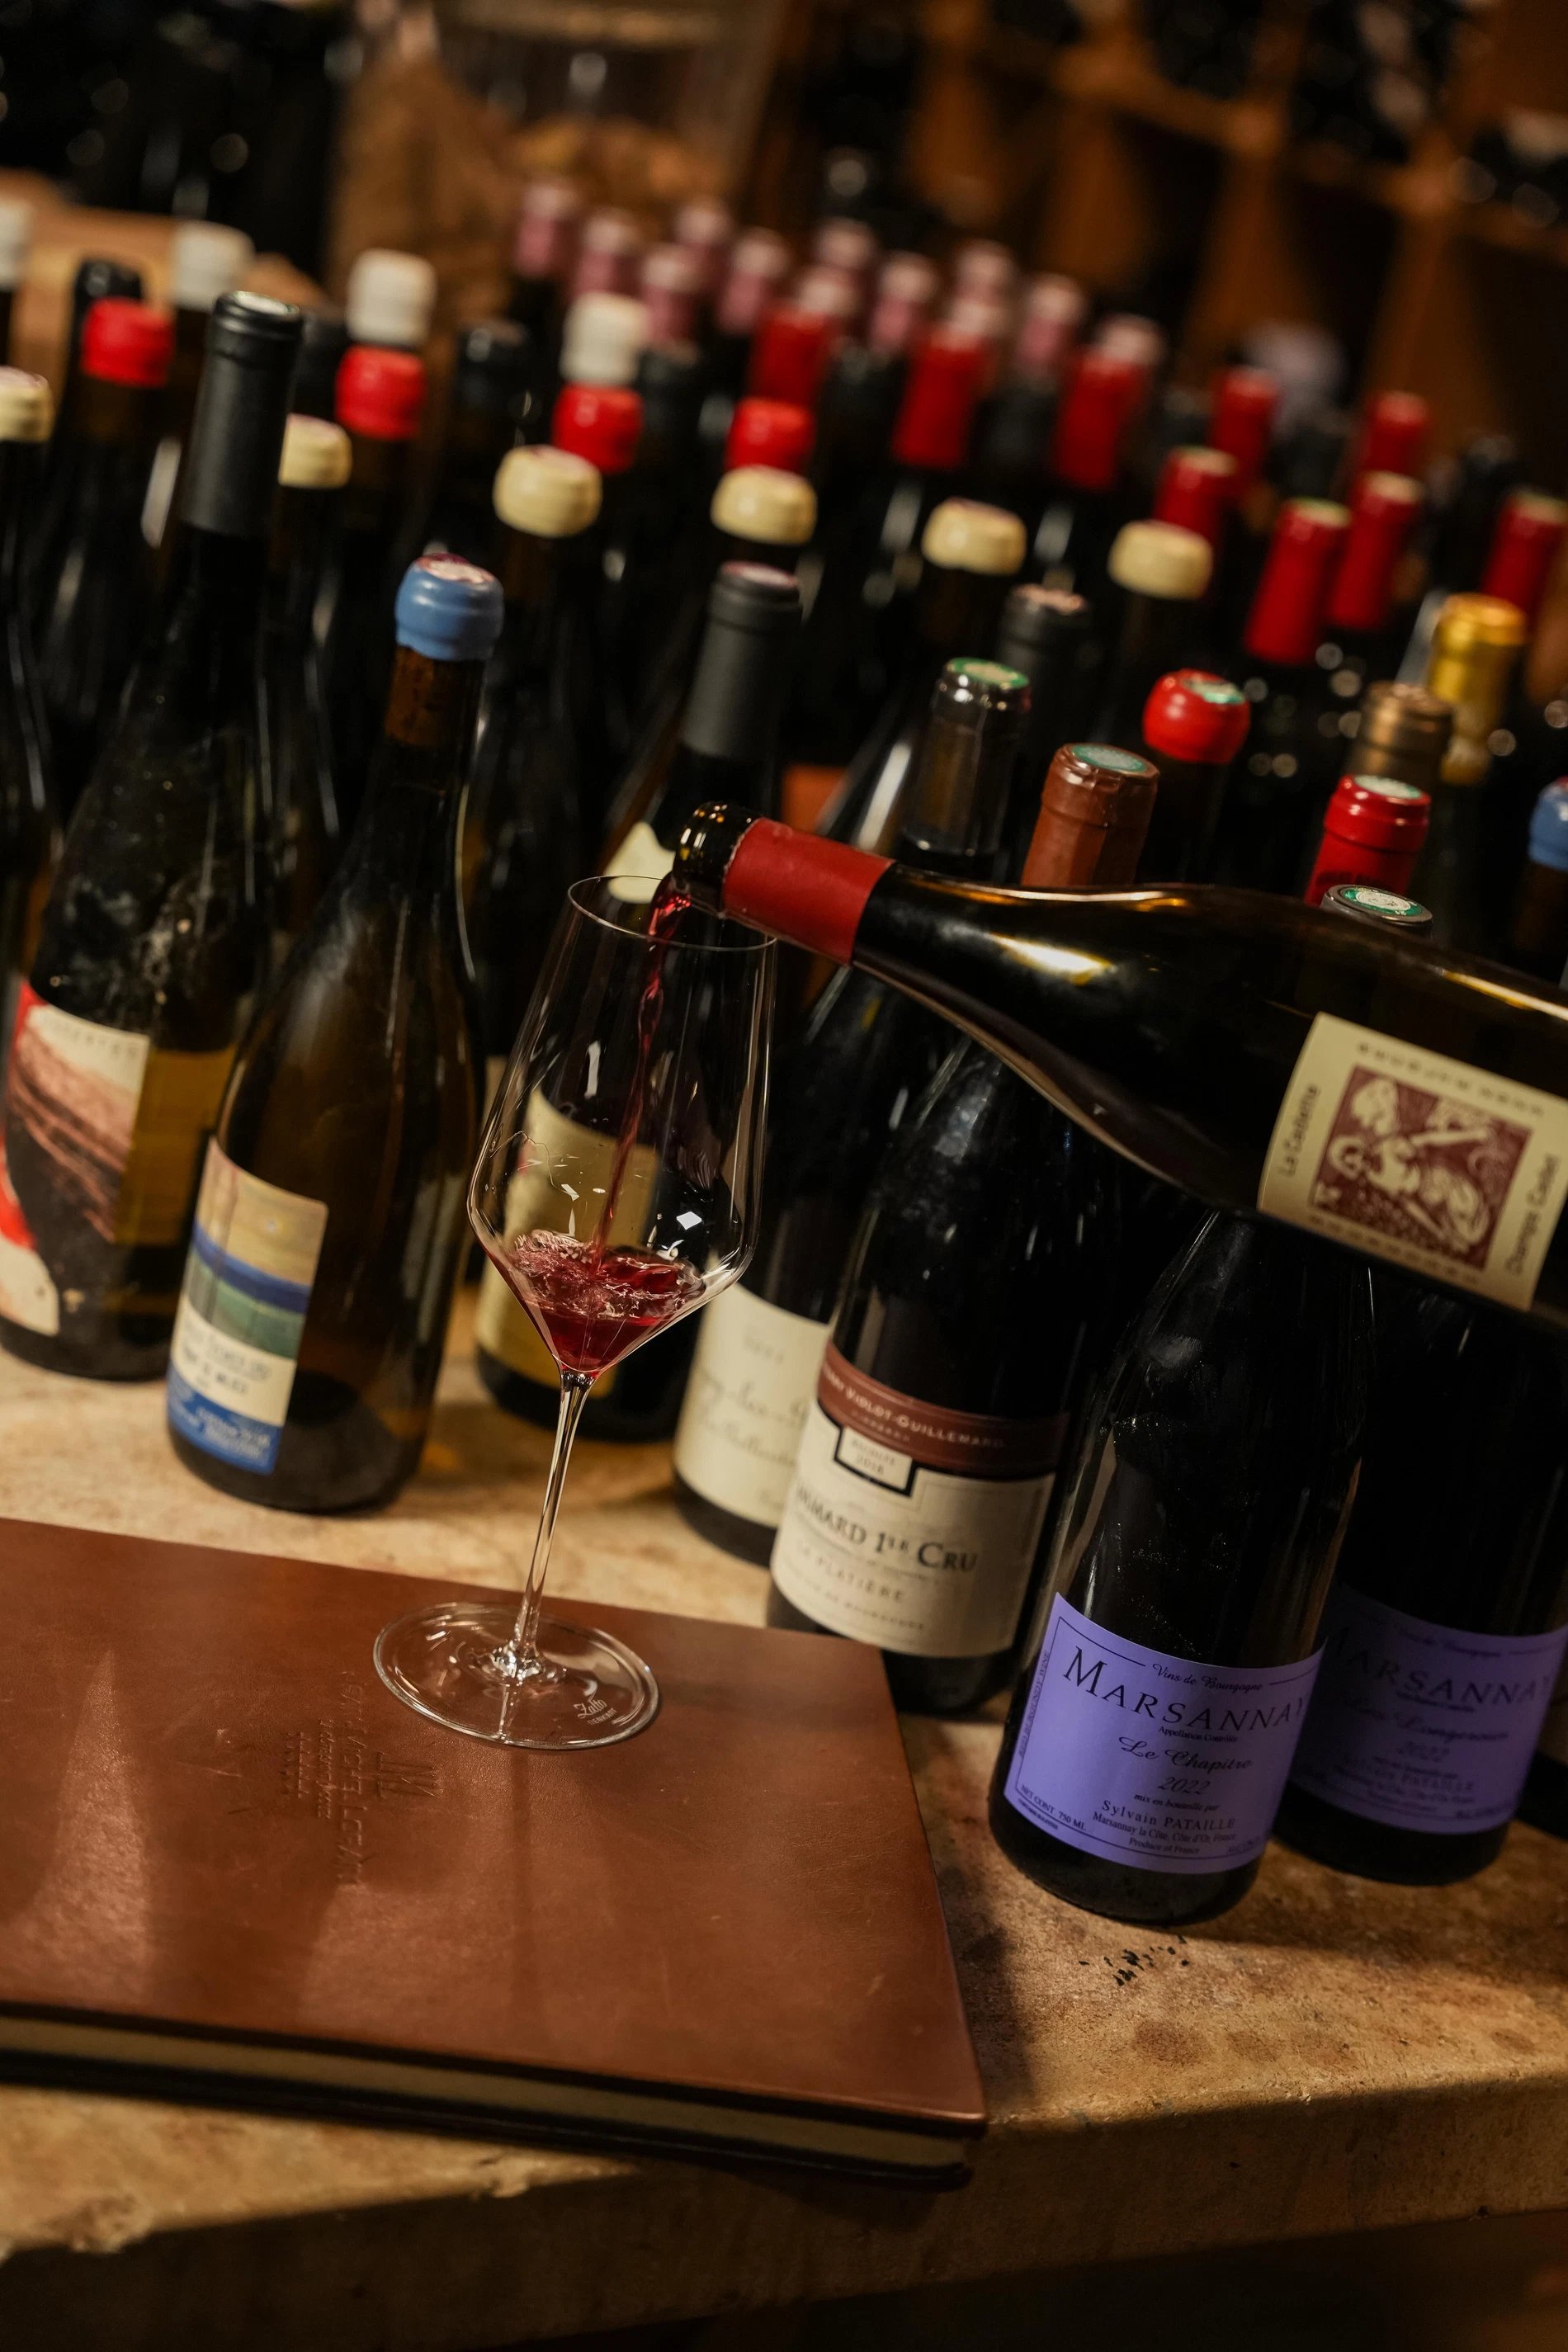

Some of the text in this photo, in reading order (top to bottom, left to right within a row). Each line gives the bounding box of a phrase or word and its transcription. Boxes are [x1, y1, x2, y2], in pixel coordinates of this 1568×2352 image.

[1153, 1663, 1263, 1693] Vins de Bourgogne
[573, 1699, 607, 1719] Zalto
[1118, 1736, 1254, 1774] Le Chapitre
[1158, 1777, 1211, 1794] 2022
[1093, 1811, 1137, 1835] Marsannay
[1139, 1826, 1147, 1836] la
[1102, 1800, 1236, 1831] Sylvain PATAILLE
